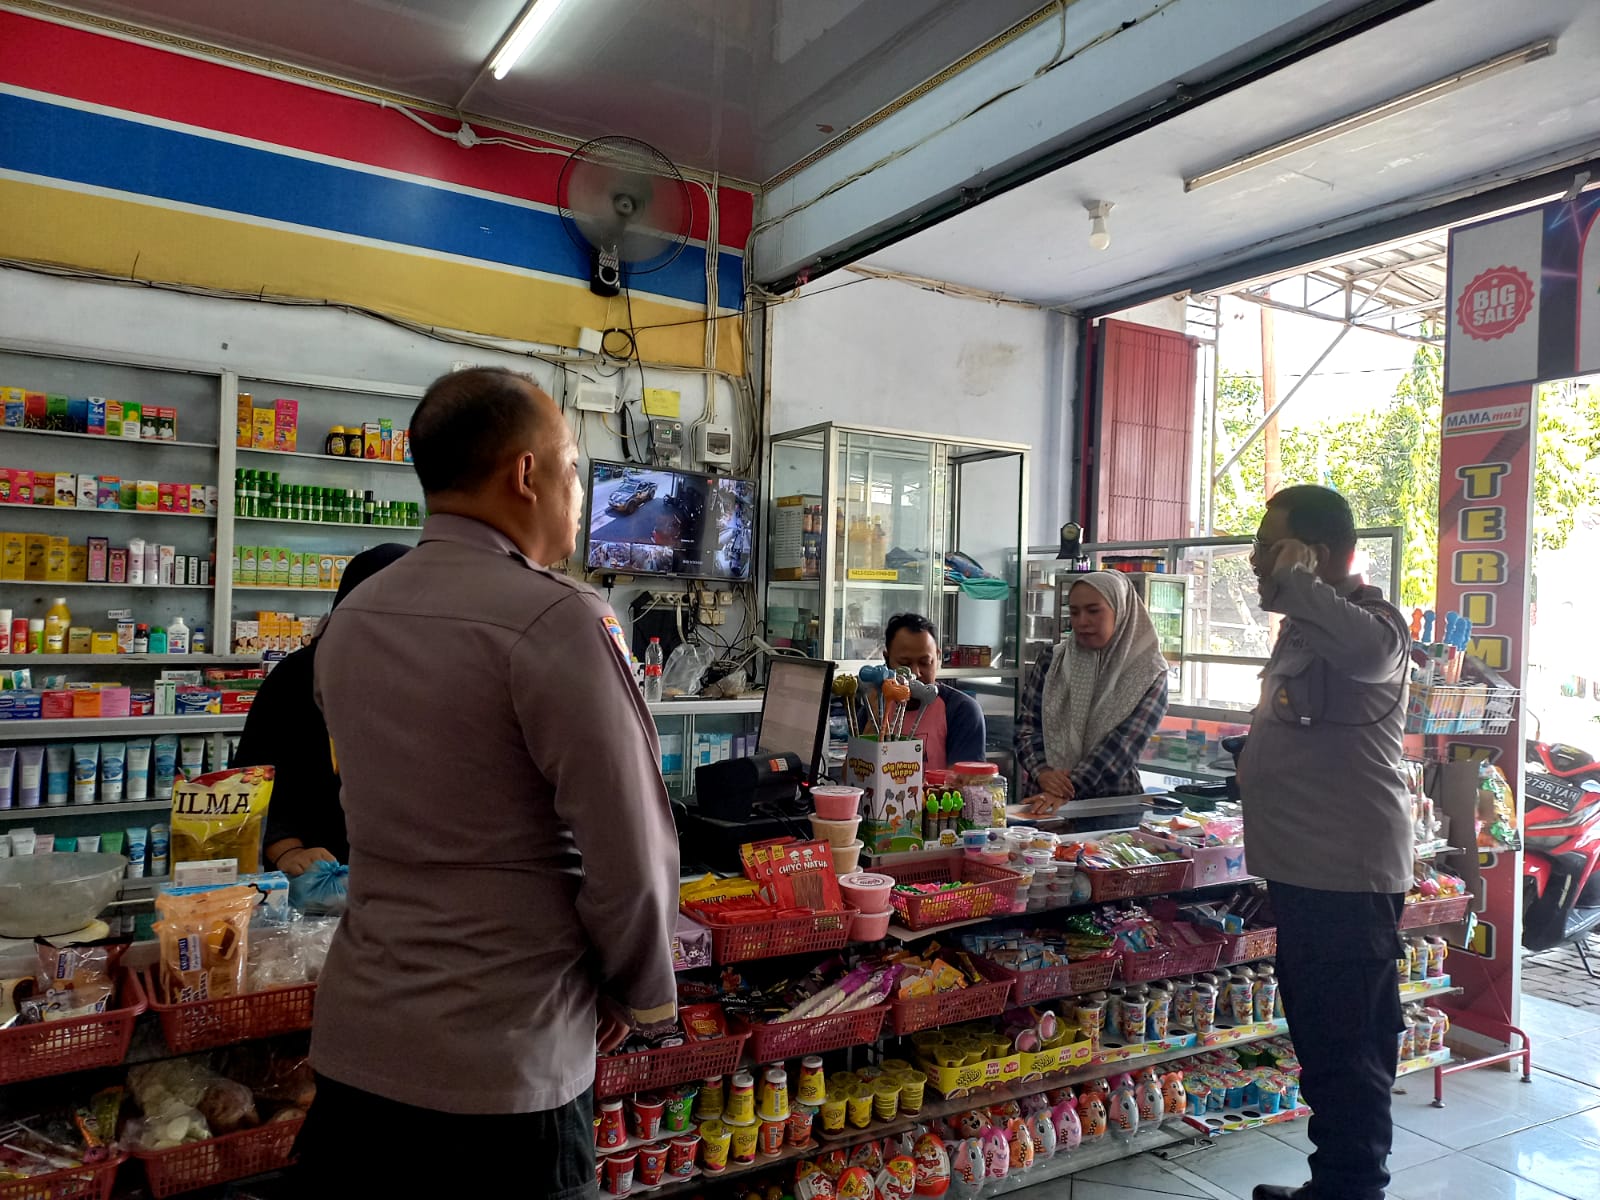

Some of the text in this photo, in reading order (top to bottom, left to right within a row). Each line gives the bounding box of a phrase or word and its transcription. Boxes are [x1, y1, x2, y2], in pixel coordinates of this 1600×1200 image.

[1472, 283, 1517, 311] BIG
[1472, 303, 1516, 327] SALE
[1446, 406, 1524, 427] MAMA mart
[1453, 462, 1512, 673] TERIM
[174, 790, 251, 815] ILMA
[778, 863, 802, 874] CHIYO
